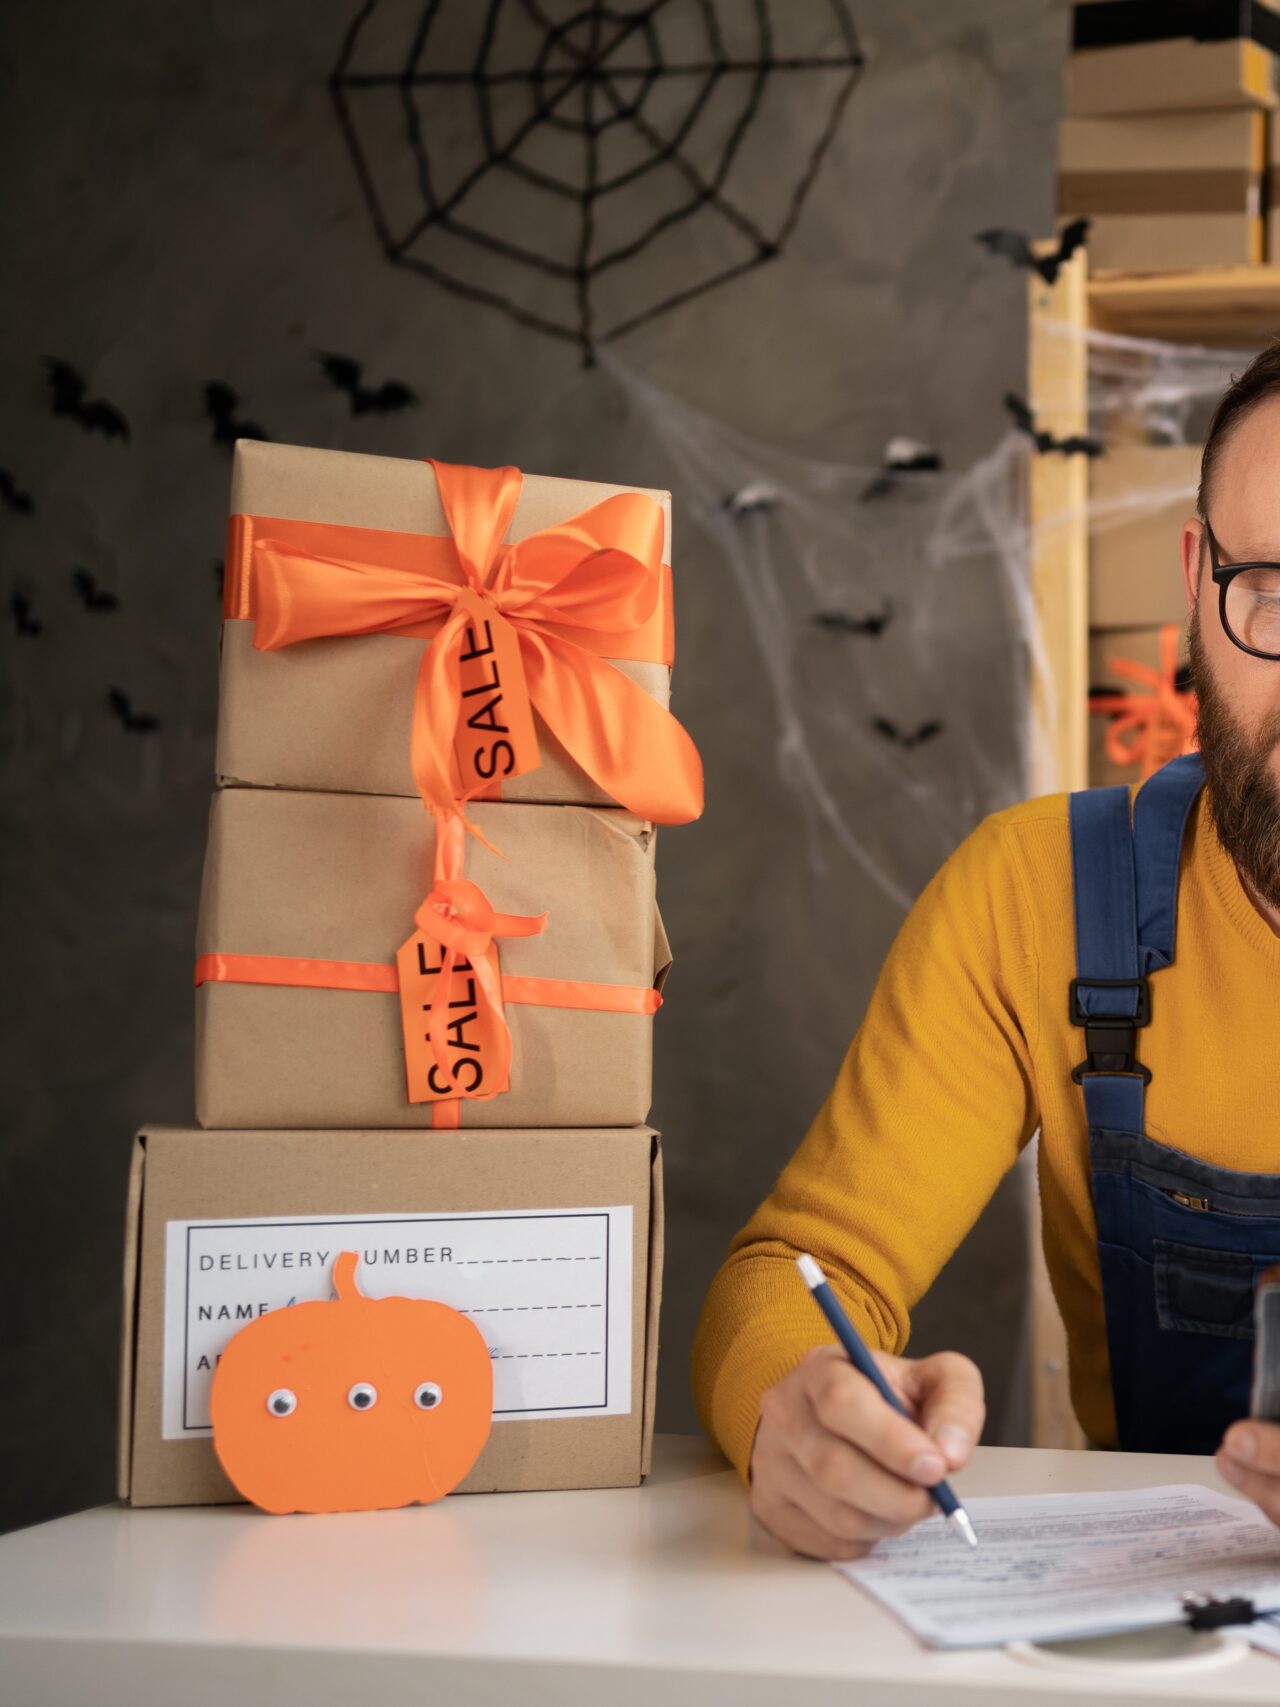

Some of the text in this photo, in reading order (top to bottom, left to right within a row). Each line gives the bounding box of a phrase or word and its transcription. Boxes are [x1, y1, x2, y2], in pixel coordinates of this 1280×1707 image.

[460, 620, 515, 779] SALE
[199, 1247, 453, 1271] DELIVERY UMBER
